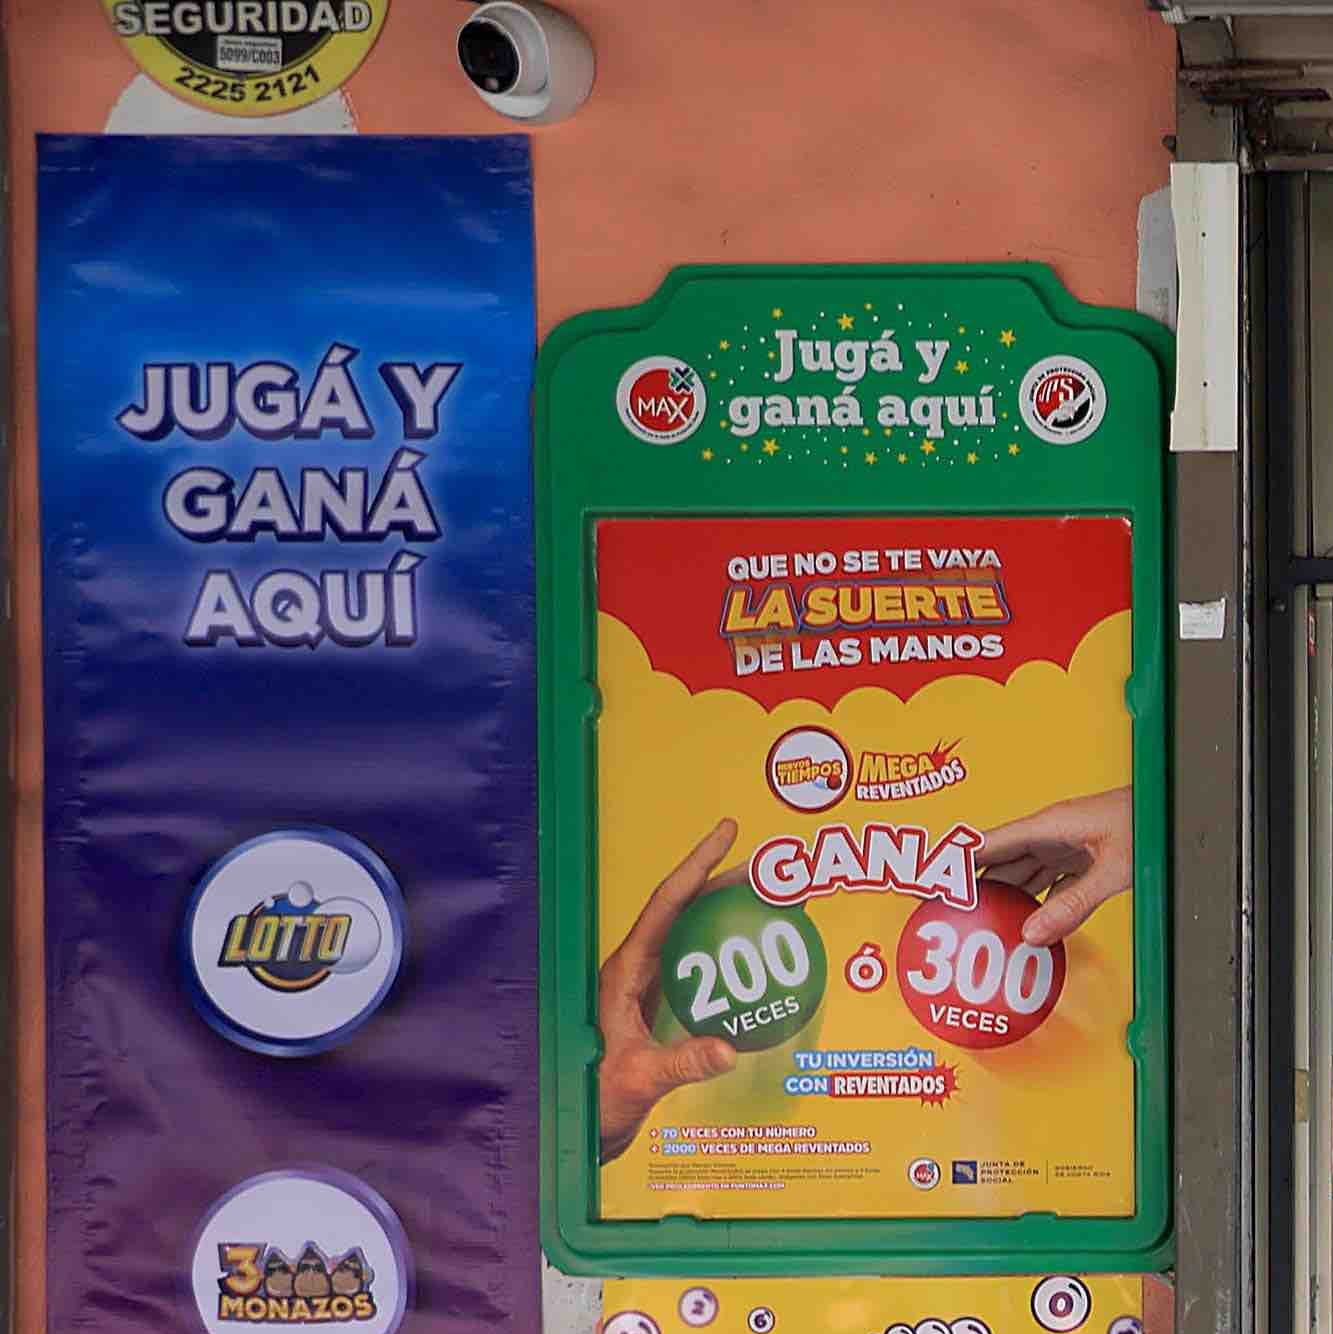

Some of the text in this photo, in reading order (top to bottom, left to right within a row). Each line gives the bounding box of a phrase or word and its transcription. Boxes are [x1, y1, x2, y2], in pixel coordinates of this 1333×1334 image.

[115, 0, 372, 35] SEGURIDAD
[174, 66, 321, 102] 2225 2121
[774, 329, 949, 382] Jugá y
[116, 343, 464, 440] JUGÁ Y
[638, 396, 688, 423] MAX
[728, 390, 863, 437] ganá
[877, 386, 997, 438] aquí
[163, 448, 442, 542] GANÁ
[728, 548, 1001, 581] QUE NO SE TE VAYA
[183, 551, 427, 650] AQUÍ
[723, 583, 1006, 633] LA SUERTE
[736, 634, 1004, 676] DE LAS MANOS
[856, 759, 965, 800] REVENTADOS
[860, 752, 933, 783] MEGA
[750, 824, 984, 910] GANÁ
[219, 915, 352, 967] LOTTO
[678, 920, 811, 1023] 200
[907, 921, 1054, 1014] 300
[723, 997, 800, 1038] VECES
[929, 1003, 1009, 1034] VECES
[795, 1047, 934, 1069] TU INVERSIÓN
[785, 1074, 945, 1097] CON REVENTADOS
[219, 1242, 267, 1296] 3
[219, 1293, 376, 1323] MONAZOS
